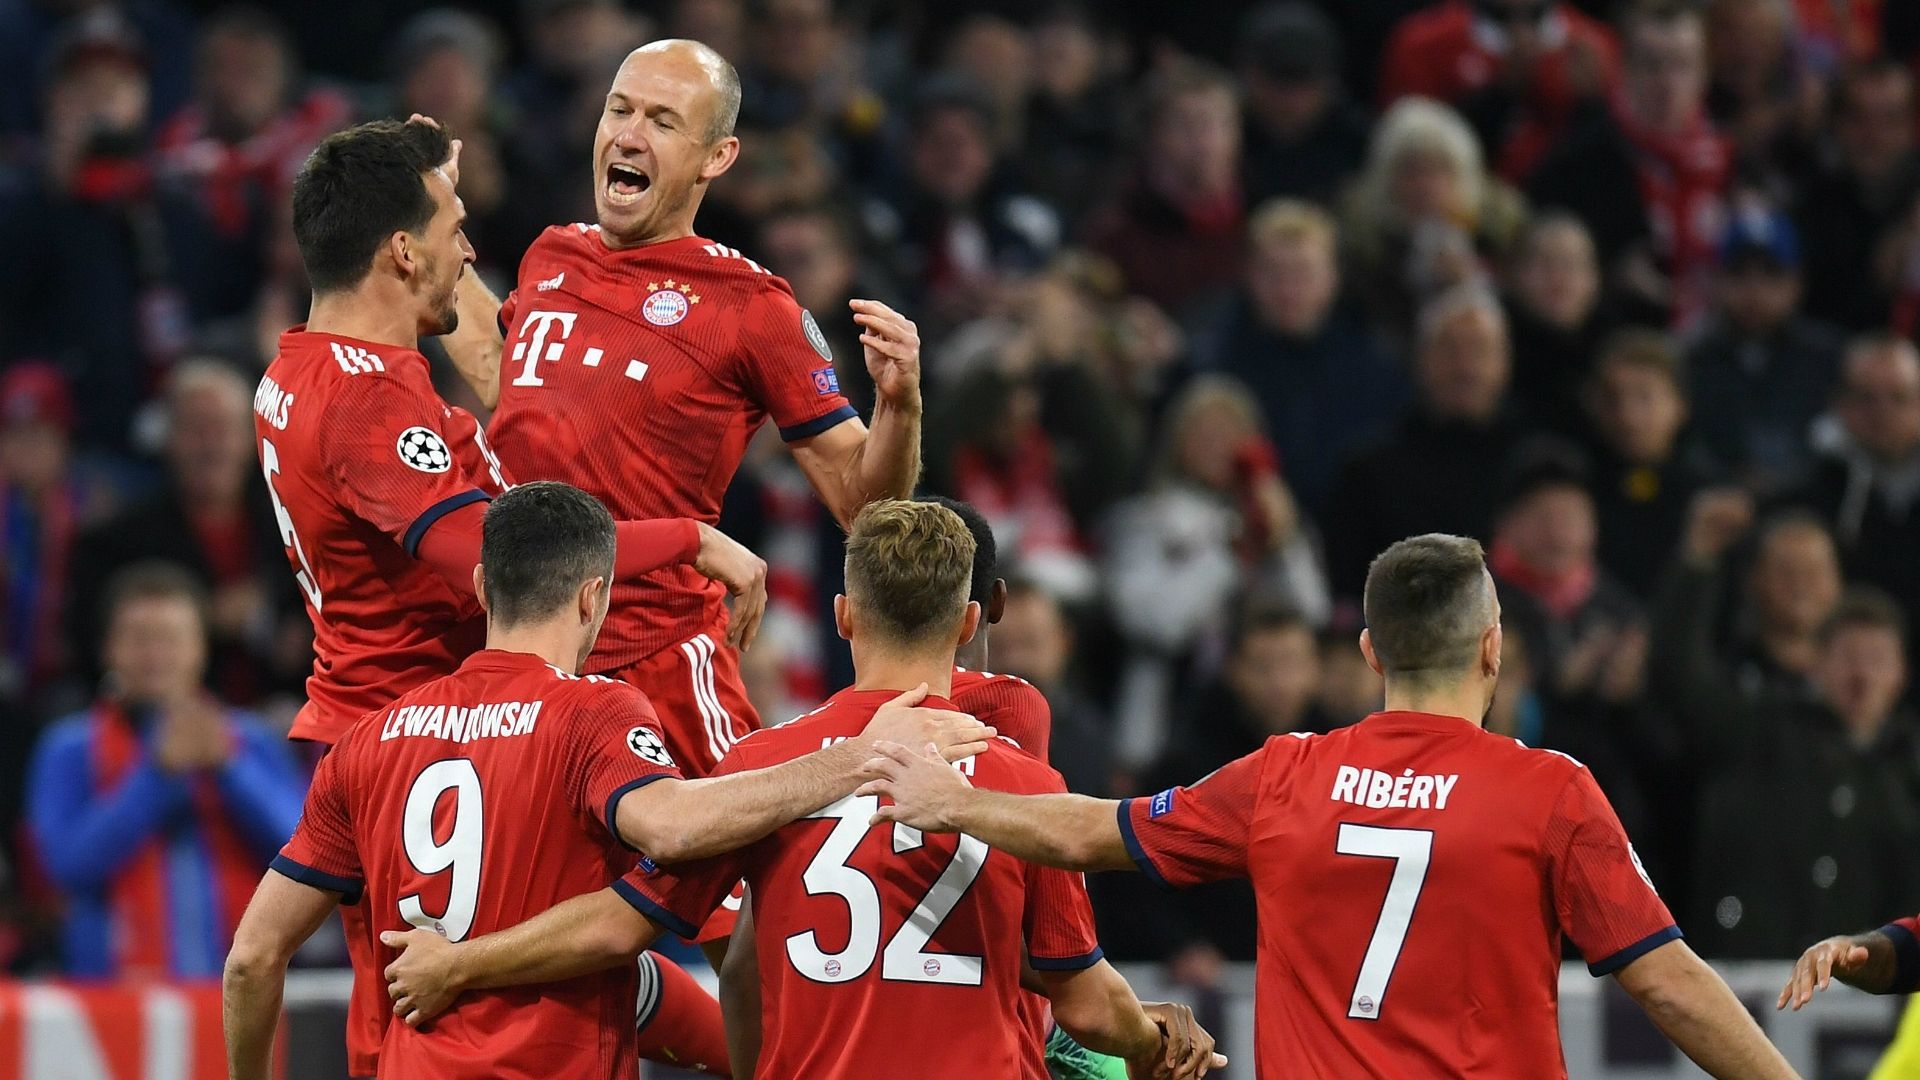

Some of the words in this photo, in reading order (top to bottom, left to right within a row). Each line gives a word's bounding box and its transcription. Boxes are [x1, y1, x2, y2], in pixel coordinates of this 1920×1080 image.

[263, 436, 322, 614] 5
[398, 757, 484, 943] 9
[1330, 765, 1459, 810] RIBÉRY
[785, 792, 987, 987] 32
[1336, 822, 1435, 1020] 7
